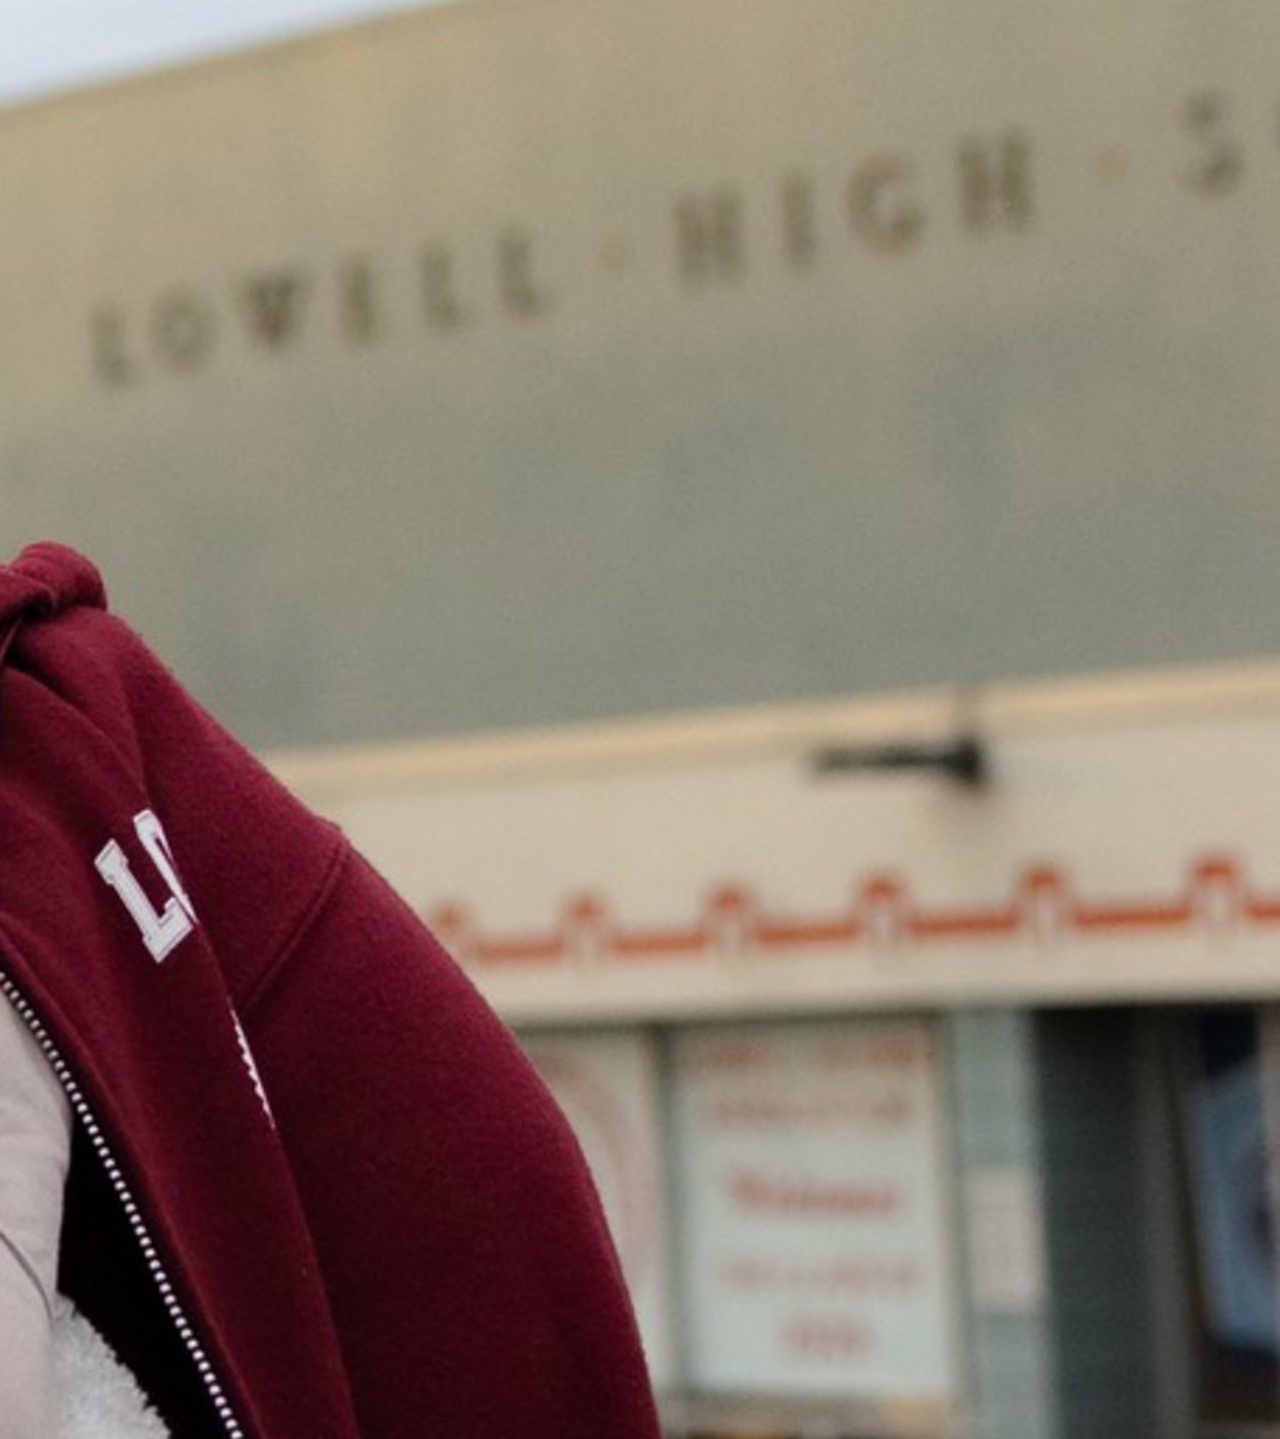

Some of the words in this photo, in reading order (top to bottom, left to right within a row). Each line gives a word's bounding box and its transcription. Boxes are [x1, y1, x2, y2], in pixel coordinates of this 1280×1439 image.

[87, 221, 547, 391] LOWELL
[667, 123, 1037, 293] HIGH
[1177, 85, 1280, 203] S
